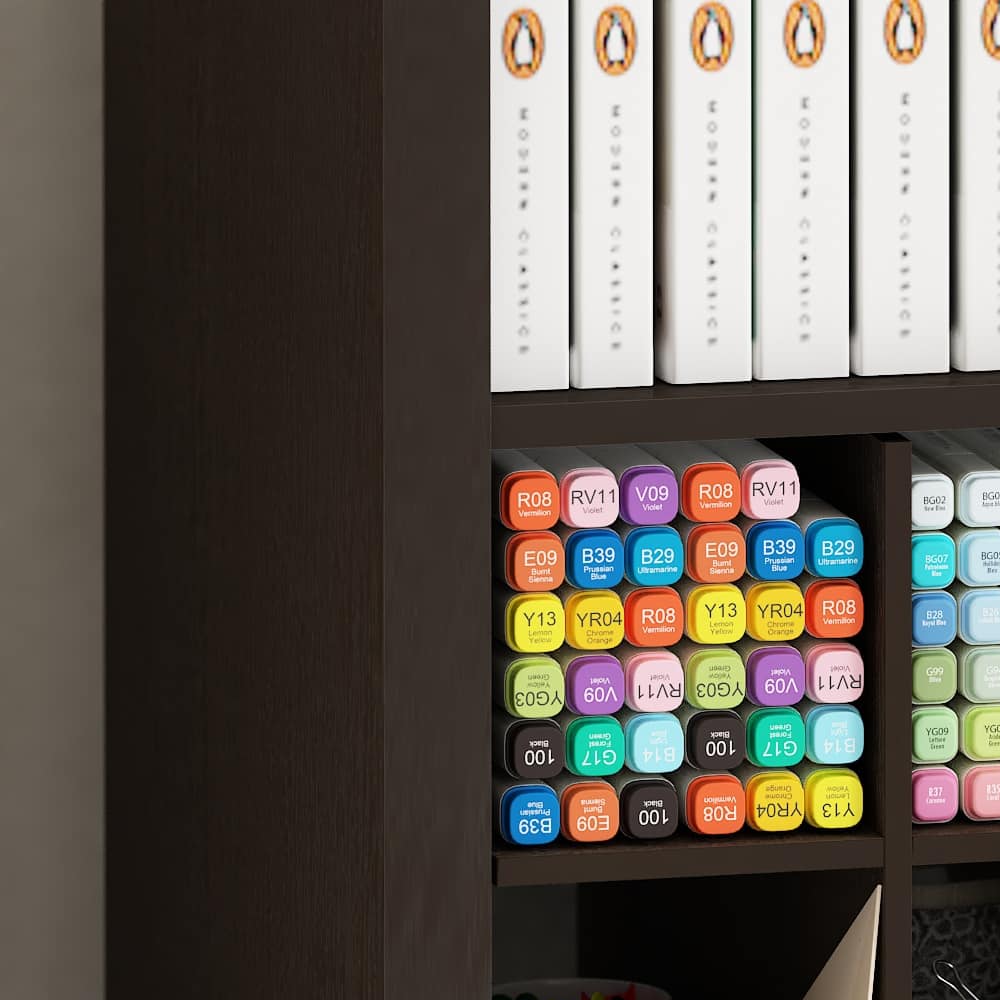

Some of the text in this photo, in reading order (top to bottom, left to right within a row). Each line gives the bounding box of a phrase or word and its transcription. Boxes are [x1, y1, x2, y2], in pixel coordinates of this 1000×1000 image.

[636, 486, 669, 502] V09
[699, 484, 733, 499] R08
[752, 482, 796, 496] RV11
[518, 492, 552, 508] R08
[571, 489, 615, 505] RV11
[923, 496, 946, 505] BG02
[700, 501, 732, 509] Vermilion
[705, 542, 738, 558] E09
[763, 540, 796, 556] B39
[822, 541, 854, 556] B29
[524, 551, 557, 566] E09
[582, 548, 615, 564] B39
[641, 549, 674, 565] B29
[765, 557, 794, 565] Prussian
[818, 558, 858, 566] Ultramarine
[926, 555, 948, 564] BG07
[638, 566, 678, 574] Ultramarine
[772, 564, 788, 572] Blue
[705, 602, 737, 619] Y13
[758, 603, 803, 618] YR04
[822, 600, 856, 615] R08
[927, 610, 943, 619] B28
[524, 611, 556, 627] Y13
[577, 611, 622, 627] YR04
[642, 608, 675, 624] R08
[586, 629, 613, 637] Chrome
[642, 626, 675, 634] Vermilion
[710, 628, 732, 636] Yellow
[768, 628, 793, 636] Orange
[588, 637, 613, 645] Orange
[830, 664, 850, 672] Violet
[650, 673, 670, 681] Violet
[818, 674, 862, 690] RV11
[638, 683, 681, 699] RV11
[697, 682, 743, 698] YG03
[765, 678, 798, 694] V09
[516, 691, 562, 707] YG03
[584, 688, 617, 702] V09
[926, 728, 948, 736] YG09
[706, 741, 735, 756] 100
[763, 741, 798, 757] G17
[824, 738, 855, 753] B14
[525, 749, 554, 765] 100
[582, 750, 617, 765] G17
[643, 748, 675, 763] B14
[704, 796, 736, 804] Vermilion
[826, 792, 850, 800] Lemon
[520, 809, 550, 817] Prussian
[639, 810, 669, 825] 100
[703, 806, 737, 821] R08
[756, 803, 802, 818] YR04
[822, 803, 854, 818] Y13
[519, 818, 552, 834] B39
[577, 816, 609, 831] E09
